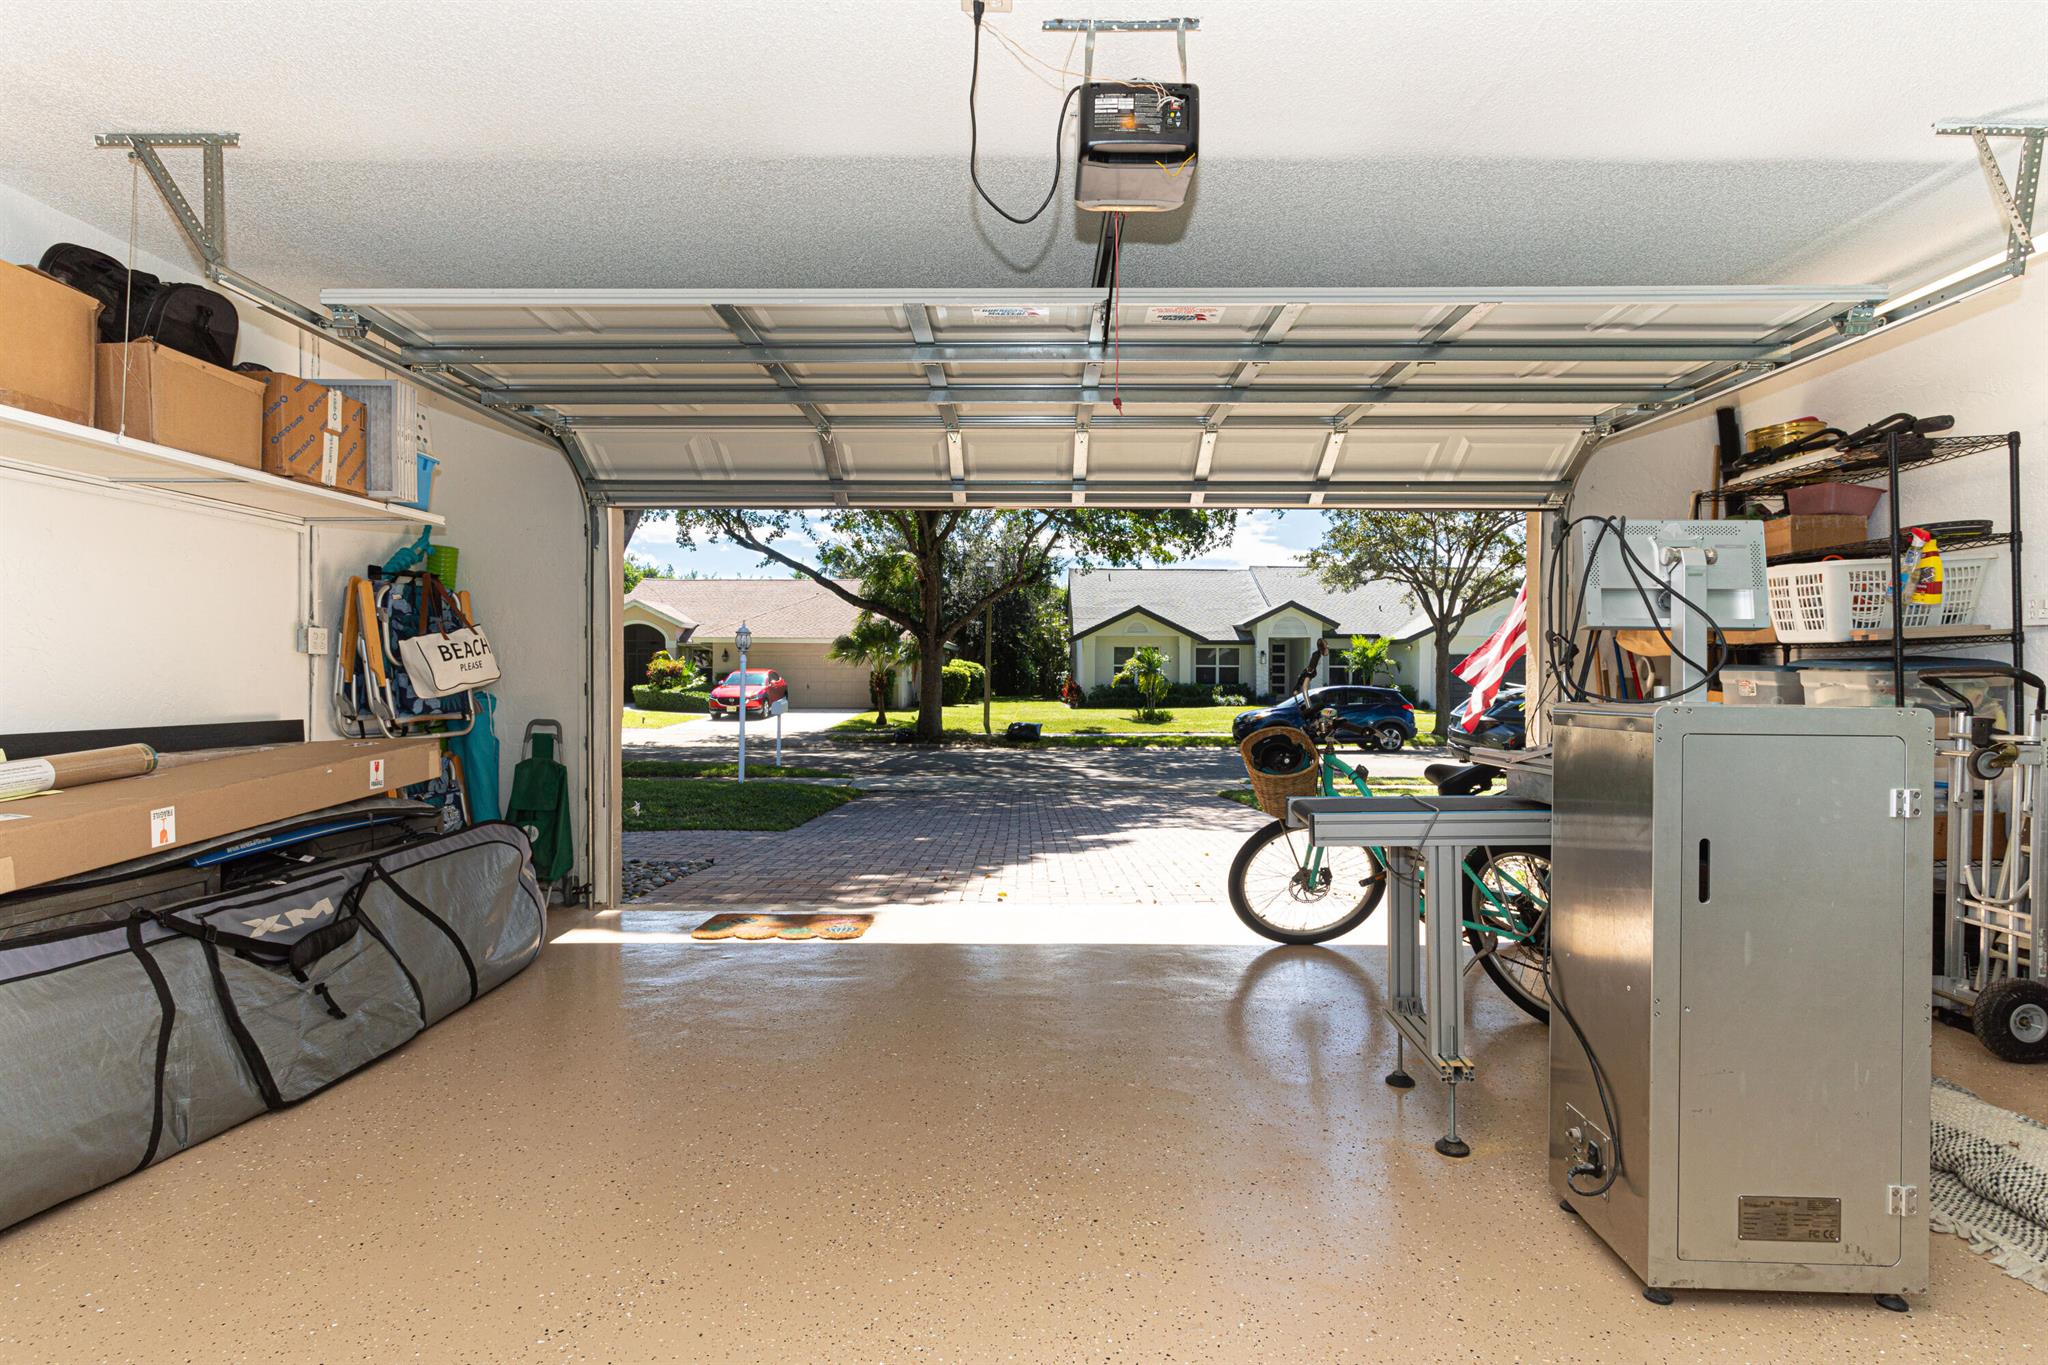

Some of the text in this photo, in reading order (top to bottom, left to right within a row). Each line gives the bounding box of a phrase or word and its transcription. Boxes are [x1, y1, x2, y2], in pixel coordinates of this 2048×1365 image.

[437, 638, 491, 662] BEACH
[460, 660, 482, 672] PLEASE
[240, 897, 335, 938] XM
